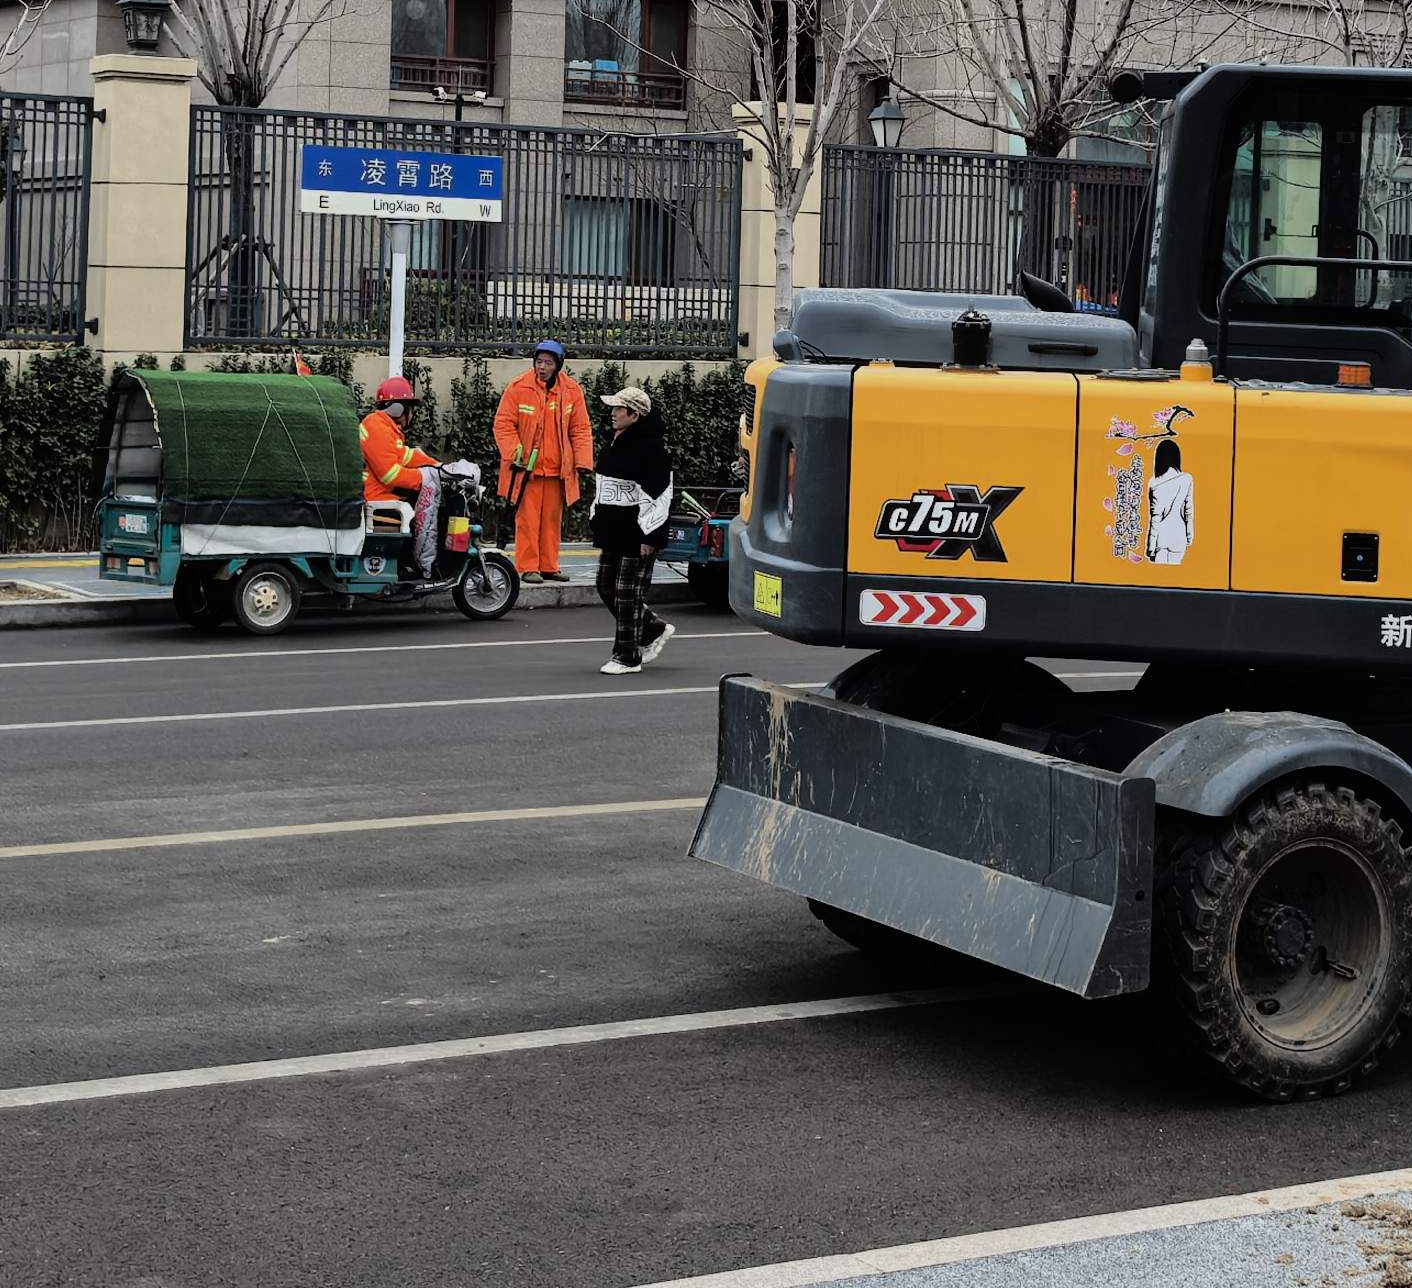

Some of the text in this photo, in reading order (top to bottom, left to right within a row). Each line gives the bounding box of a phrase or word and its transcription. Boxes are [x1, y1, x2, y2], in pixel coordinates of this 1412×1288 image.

[318, 158, 494, 191] 东 凌霄路 西
[319, 196, 492, 218] E LingXiao Rd. W
